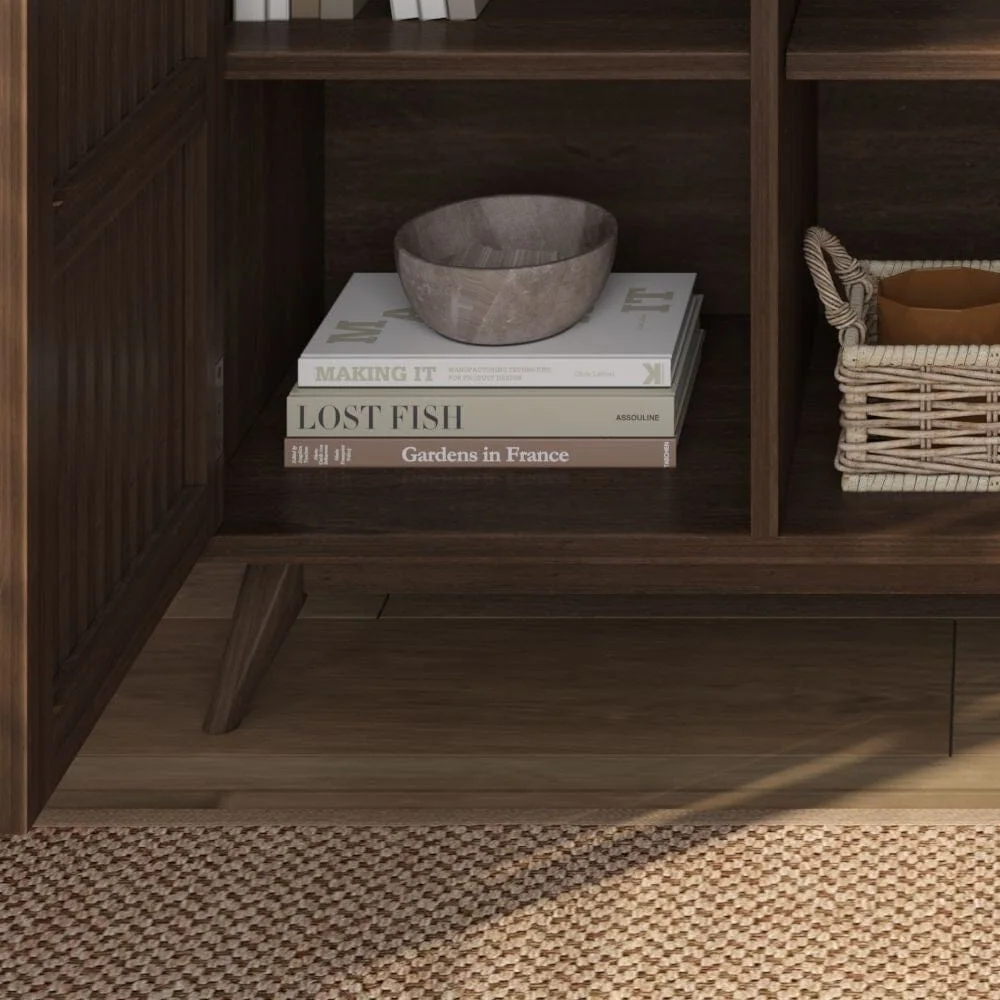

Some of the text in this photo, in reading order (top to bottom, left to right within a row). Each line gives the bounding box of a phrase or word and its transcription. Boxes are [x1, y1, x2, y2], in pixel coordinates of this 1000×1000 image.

[315, 366, 437, 381] MAKING IT
[298, 405, 464, 430] LOST FISH
[401, 446, 570, 463] Gardens in France
